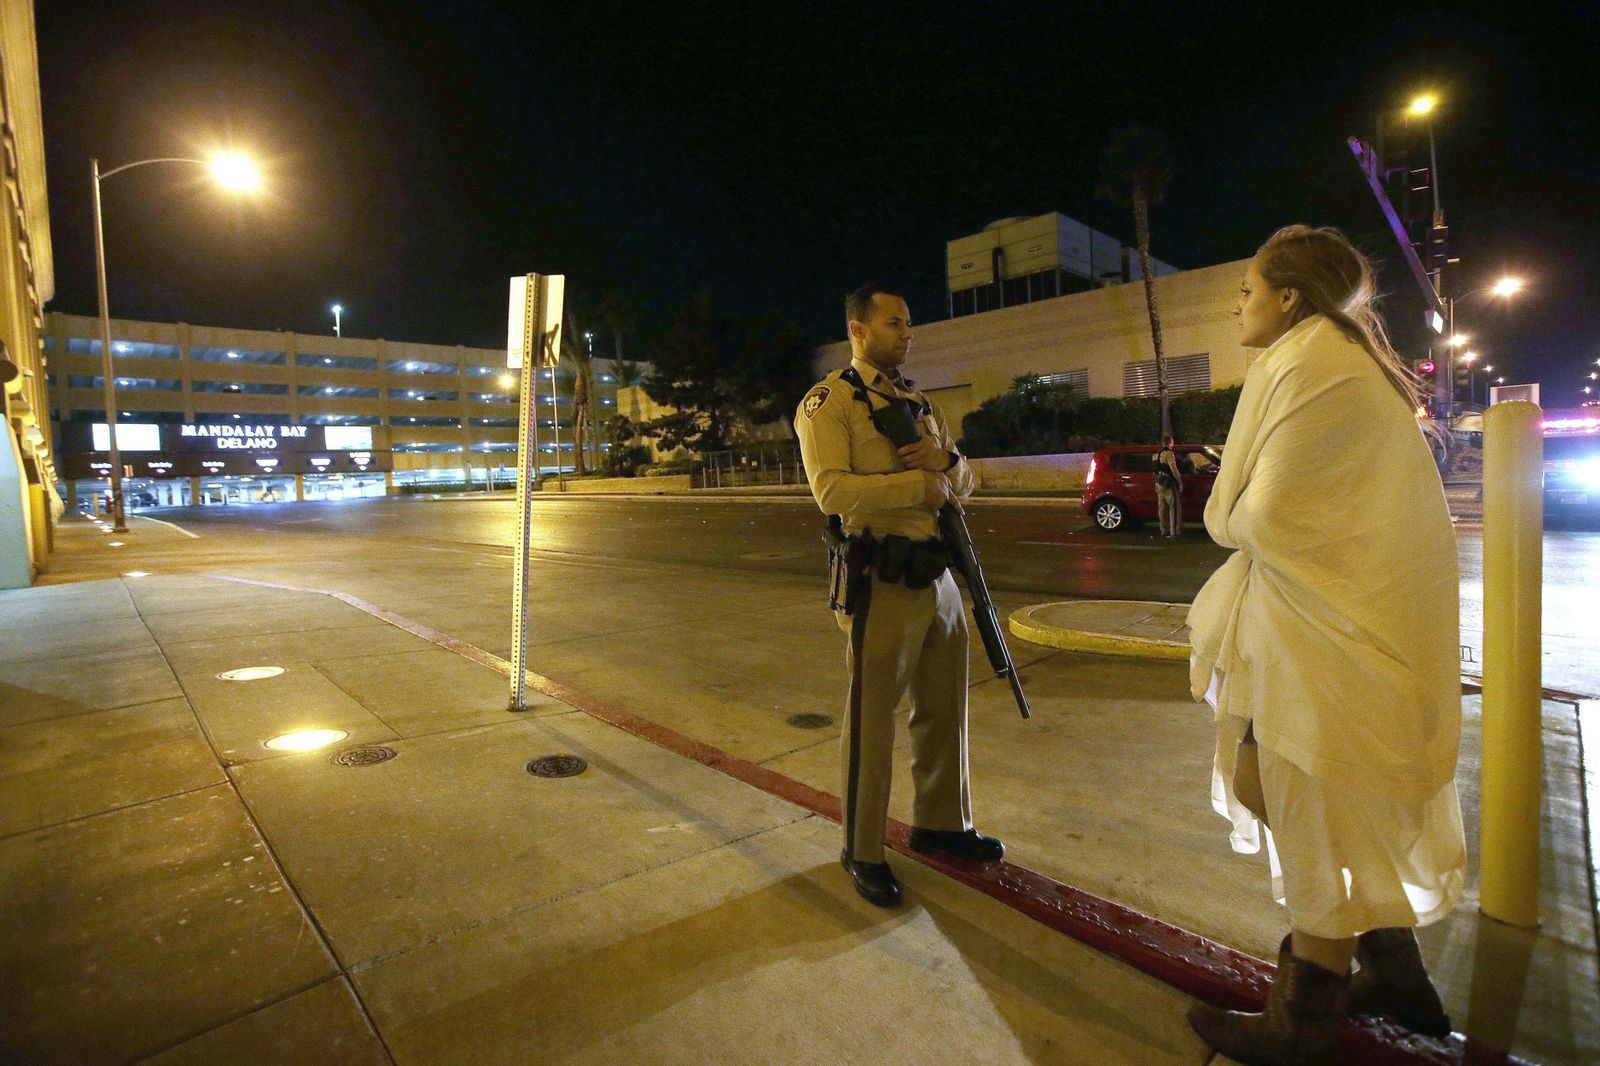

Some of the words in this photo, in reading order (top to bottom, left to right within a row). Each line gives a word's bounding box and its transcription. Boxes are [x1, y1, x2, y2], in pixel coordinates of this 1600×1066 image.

[181, 425, 275, 437] MANDALAY
[280, 425, 307, 437] BAY
[217, 437, 277, 449] DELANO
